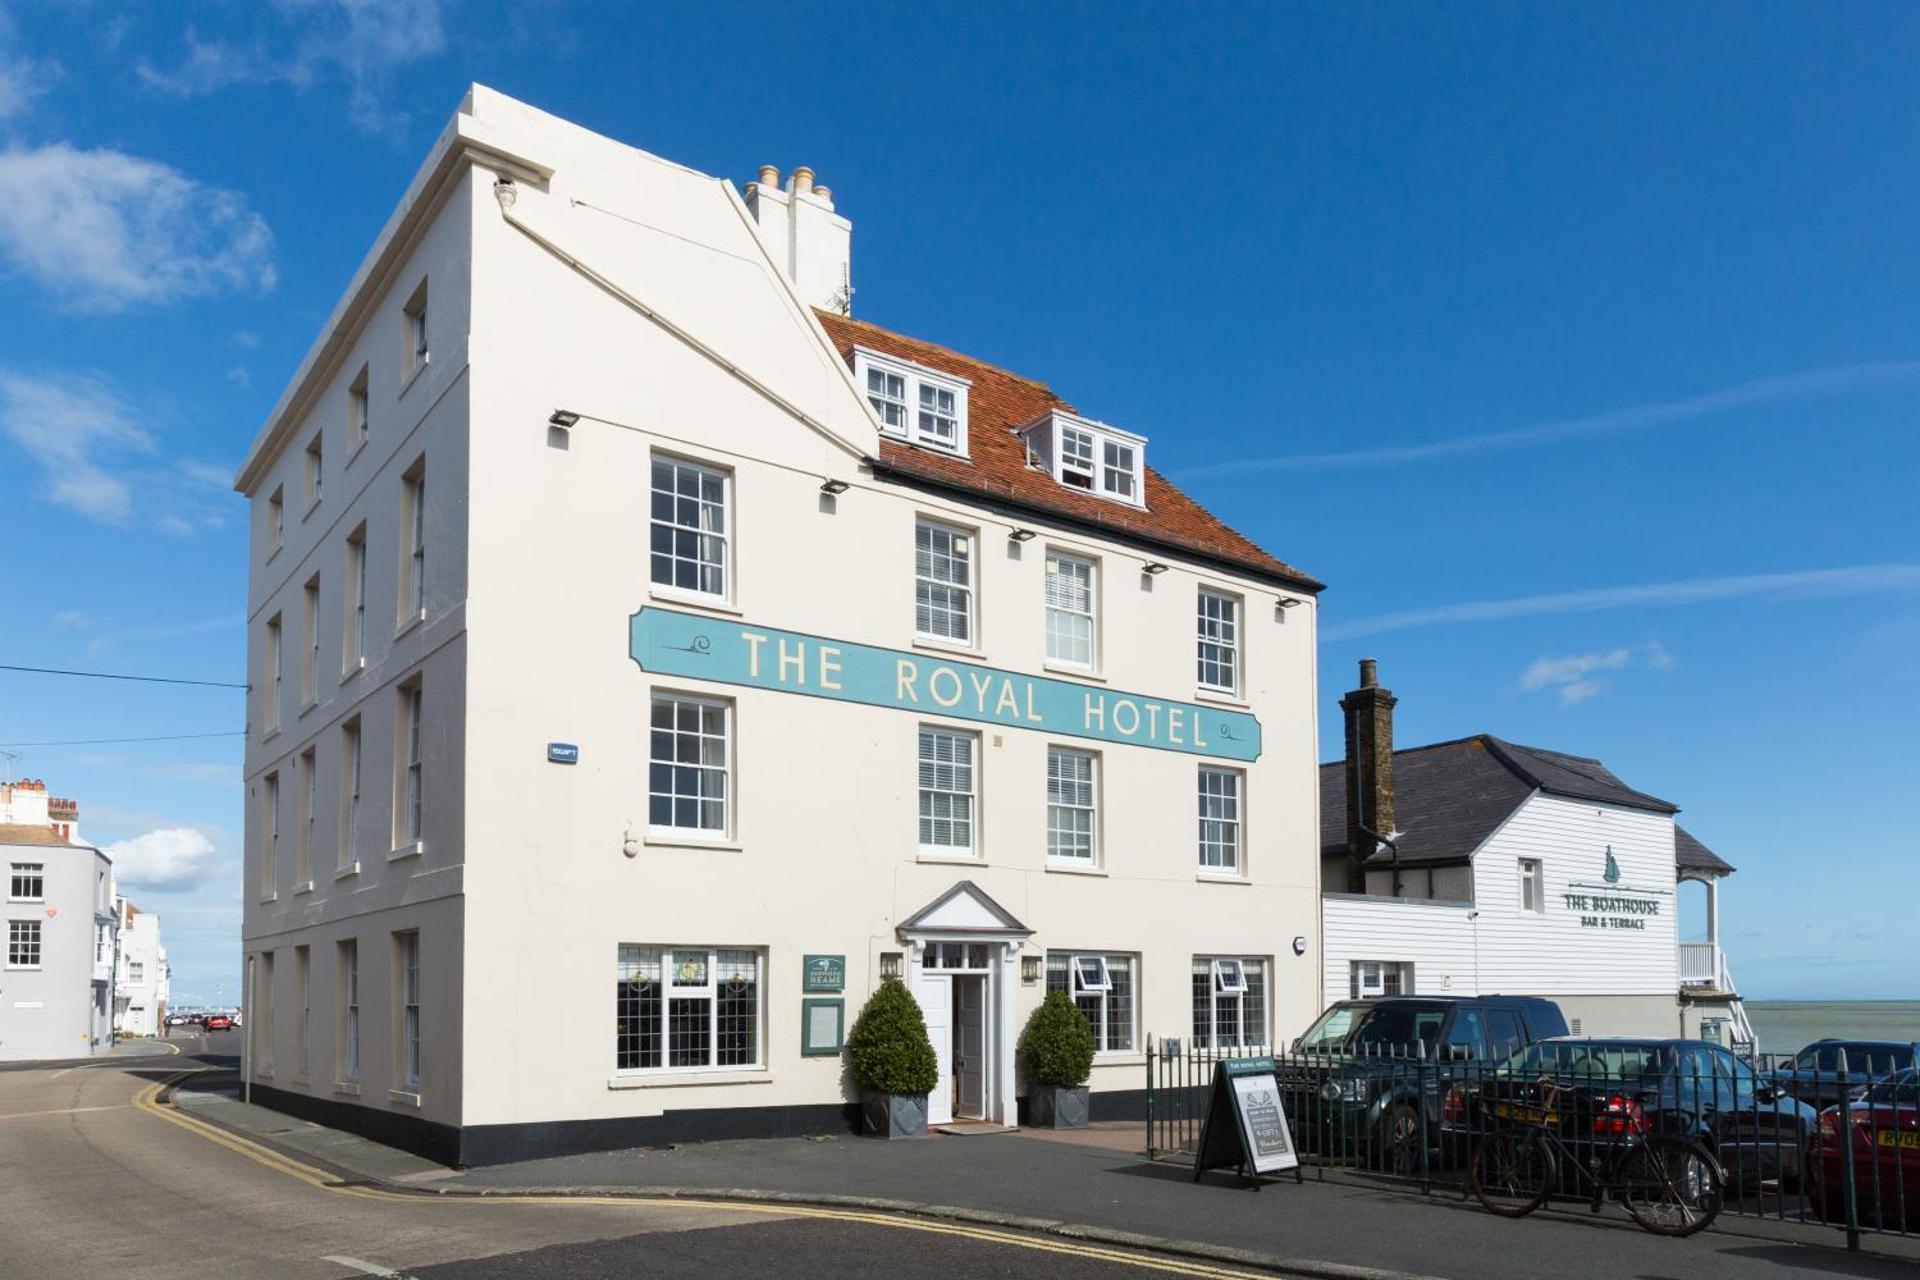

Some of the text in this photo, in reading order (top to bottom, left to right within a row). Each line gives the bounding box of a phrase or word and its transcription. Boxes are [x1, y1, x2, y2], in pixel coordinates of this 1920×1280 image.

[742, 632, 1207, 747] THE ROYAL HOTEL
[1564, 894, 1660, 915] THE BOATHOUSE
[1581, 916, 1598, 927] BAR
[1609, 918, 1645, 929] TERRACE
